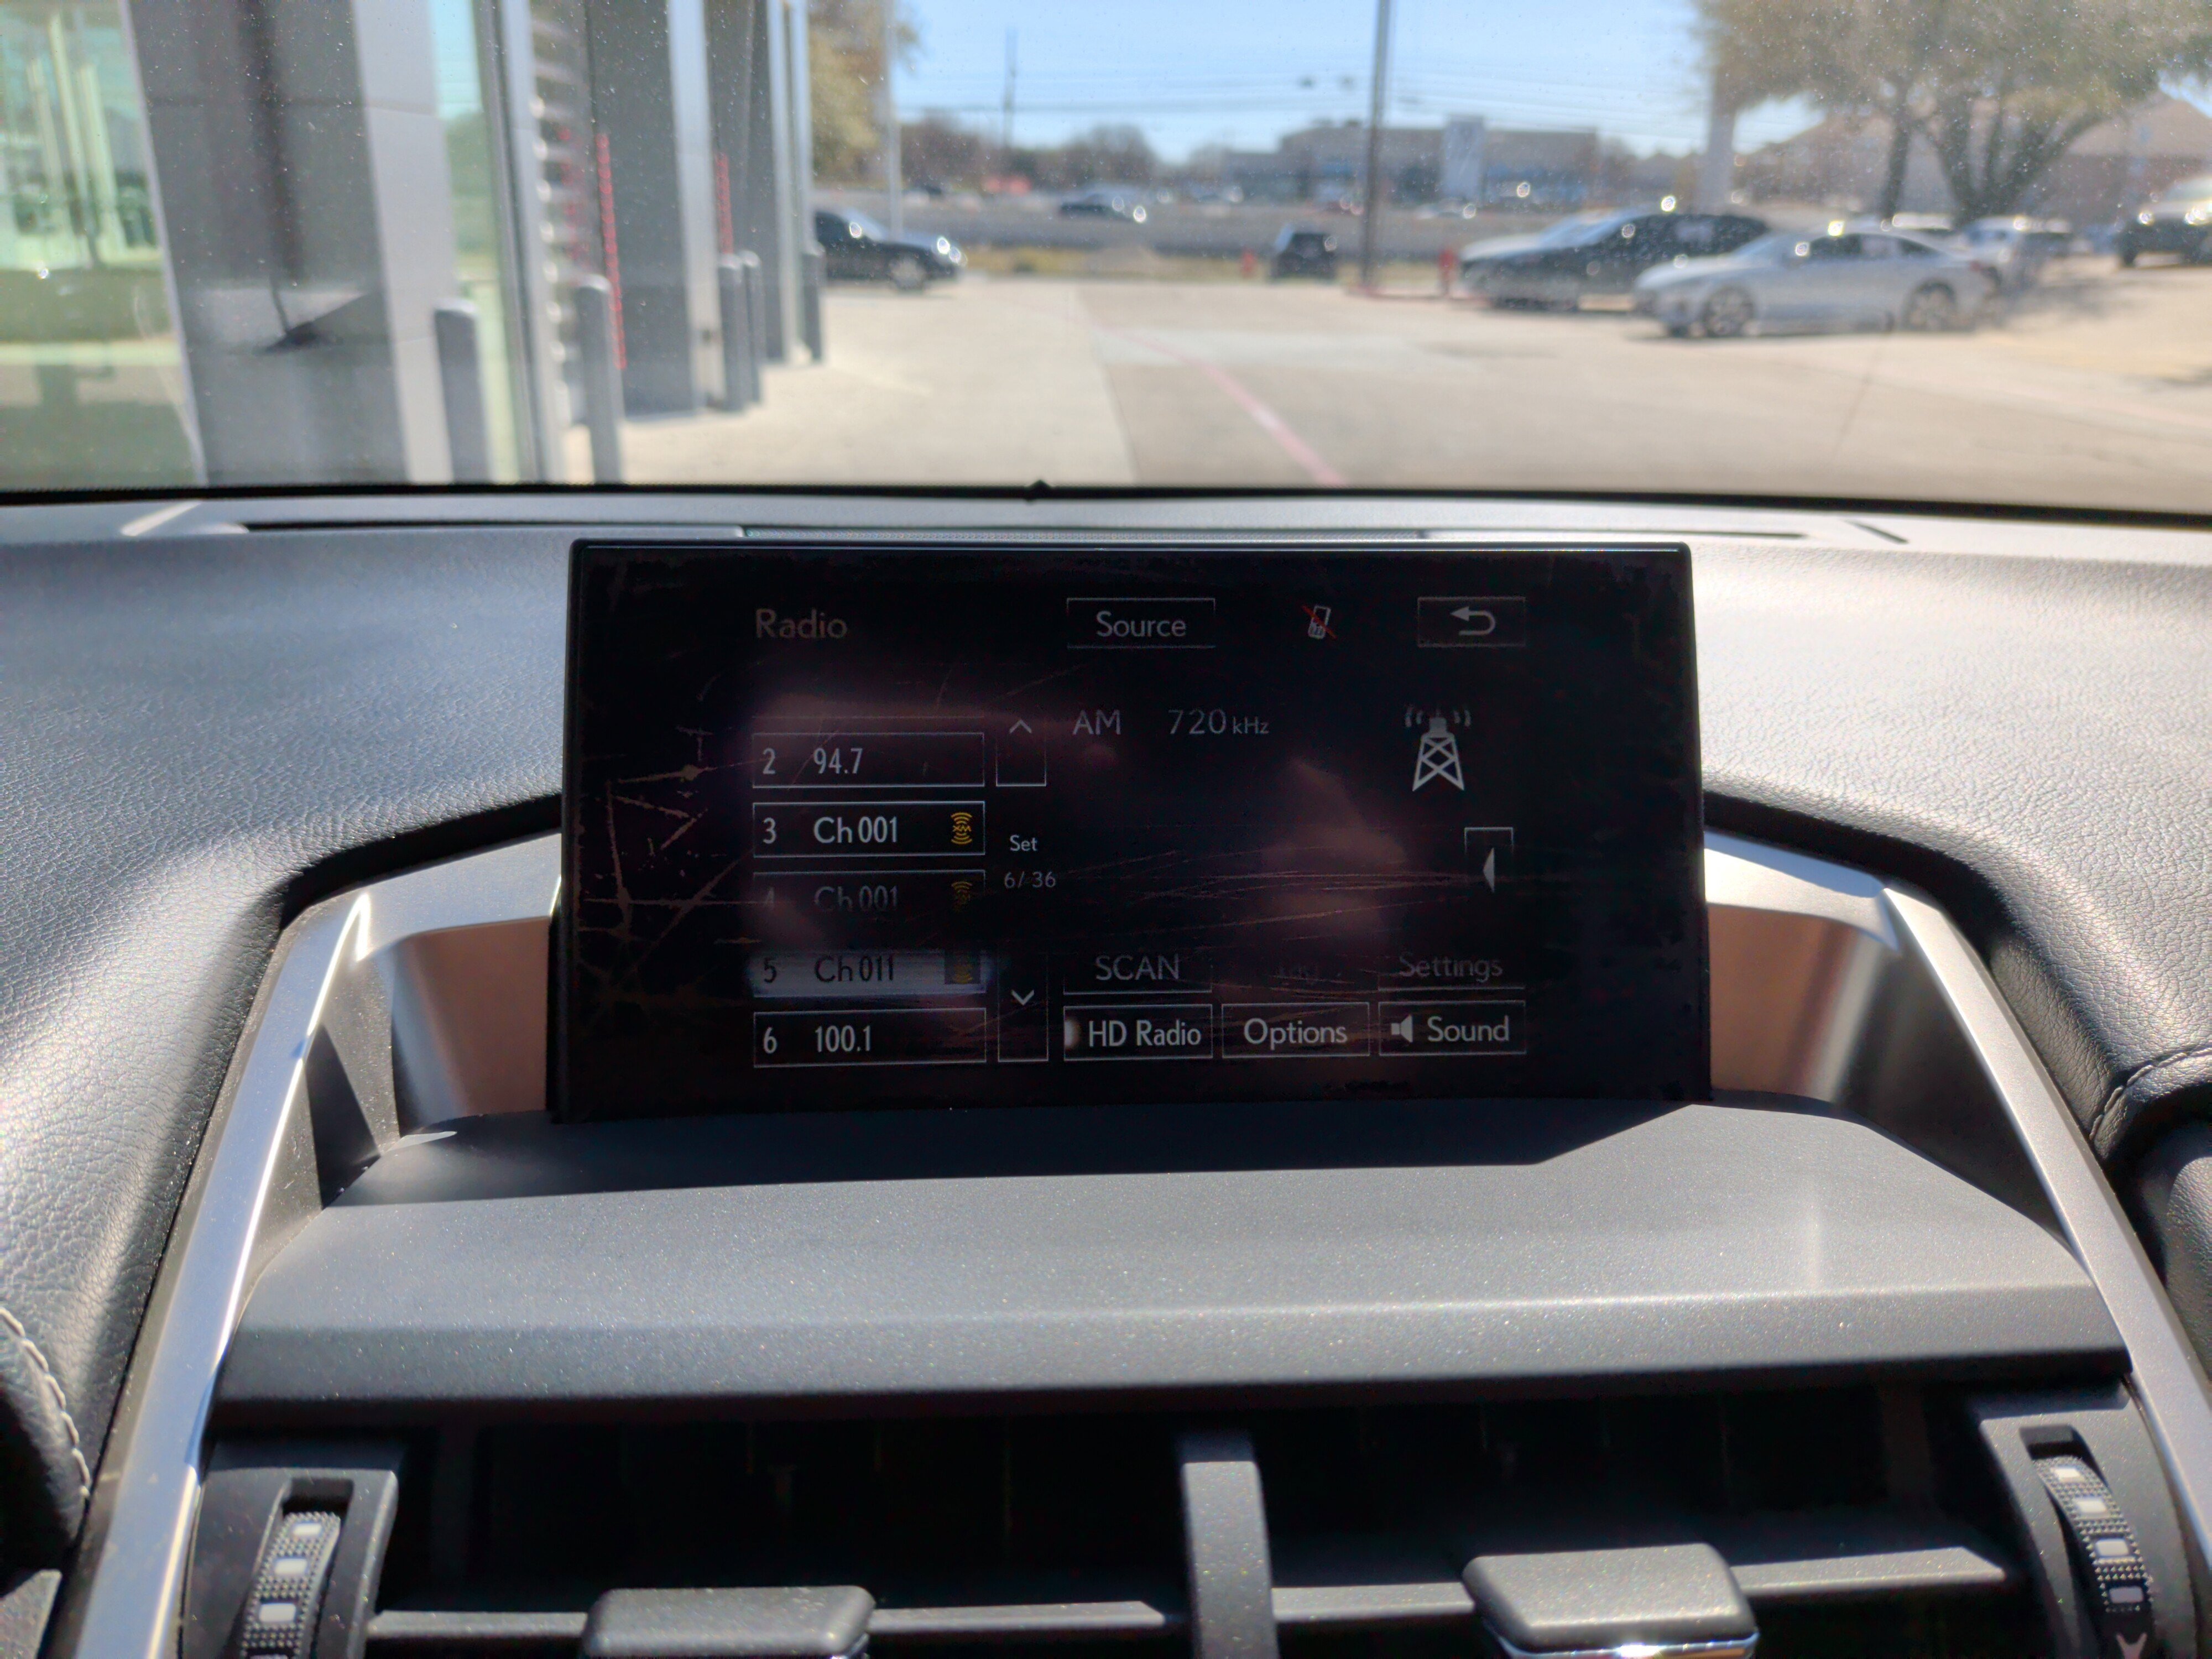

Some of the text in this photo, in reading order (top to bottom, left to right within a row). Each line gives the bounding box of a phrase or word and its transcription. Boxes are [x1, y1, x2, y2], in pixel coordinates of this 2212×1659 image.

[755, 608, 848, 639] Radio
[1095, 610, 1187, 638] Source
[1073, 708, 1122, 735] AM
[762, 748, 863, 774] 2 94.7
[762, 817, 777, 844] 3
[1009, 833, 1039, 852] Set
[763, 957, 777, 983] 5
[1094, 954, 1180, 981] SCAN
[1400, 951, 1503, 983] Settings
[763, 1025, 872, 1055] 6 100.1
[1088, 1018, 1202, 1048] HD Radio
[1243, 1018, 1348, 1051] Options
[1427, 1014, 1510, 1042] Sound
